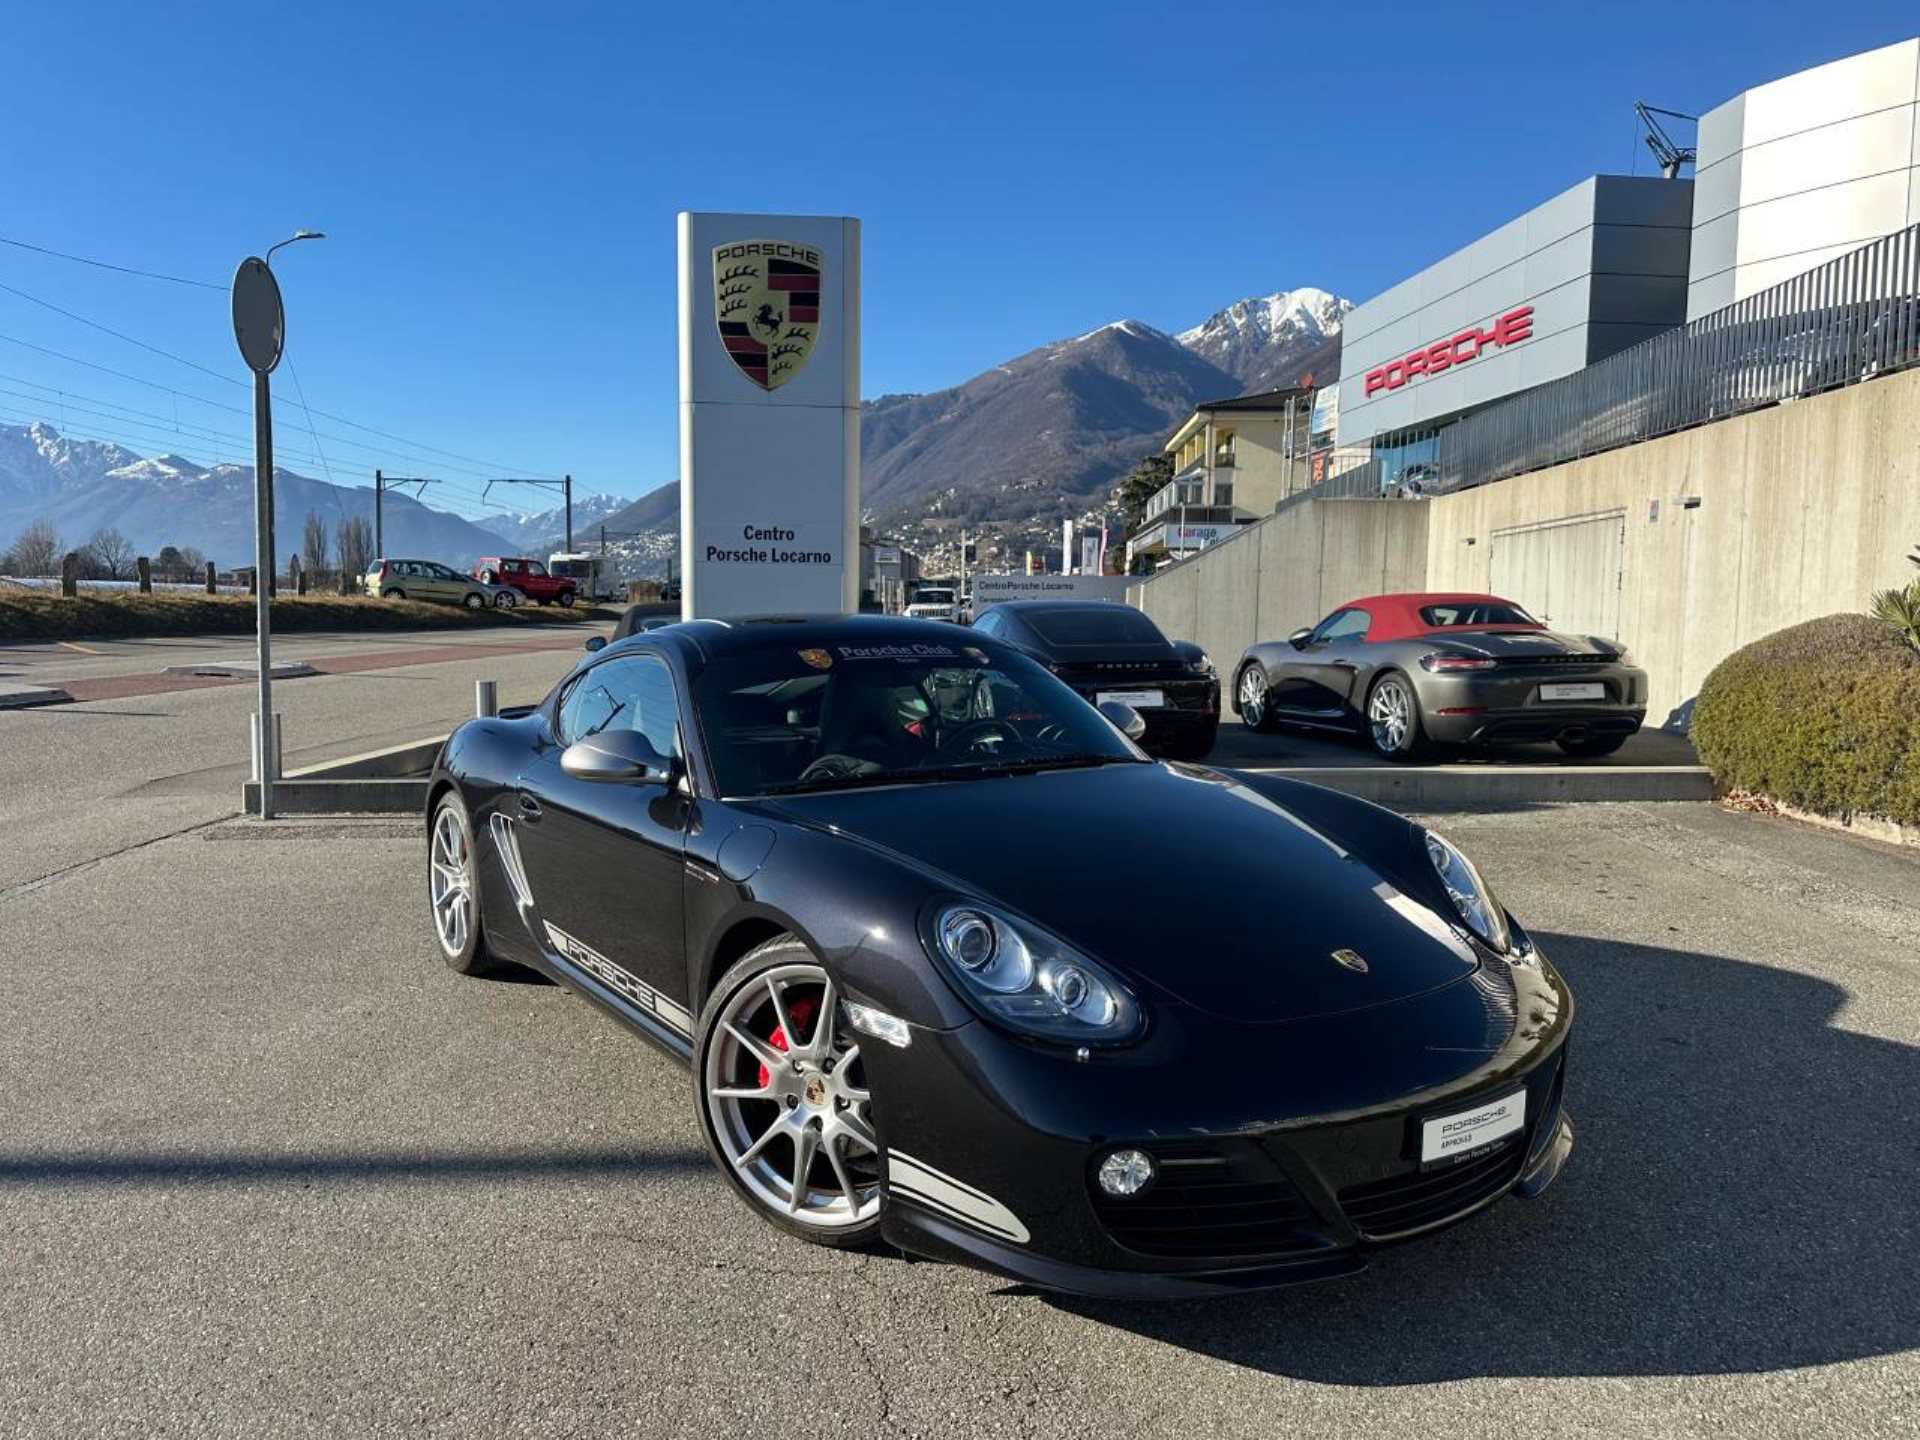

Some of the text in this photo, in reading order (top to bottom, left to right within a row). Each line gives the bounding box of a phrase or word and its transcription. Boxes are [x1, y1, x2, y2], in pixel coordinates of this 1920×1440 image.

[716, 242, 820, 267] PORSCHE
[1364, 306, 1534, 399] PORSCHE
[744, 524, 795, 541] Centro
[706, 545, 832, 564] Porsche Locarno
[838, 643, 953, 657] Porsche Club
[568, 938, 656, 1009] PORSCHE
[1441, 1106, 1507, 1134] PORSCHE
